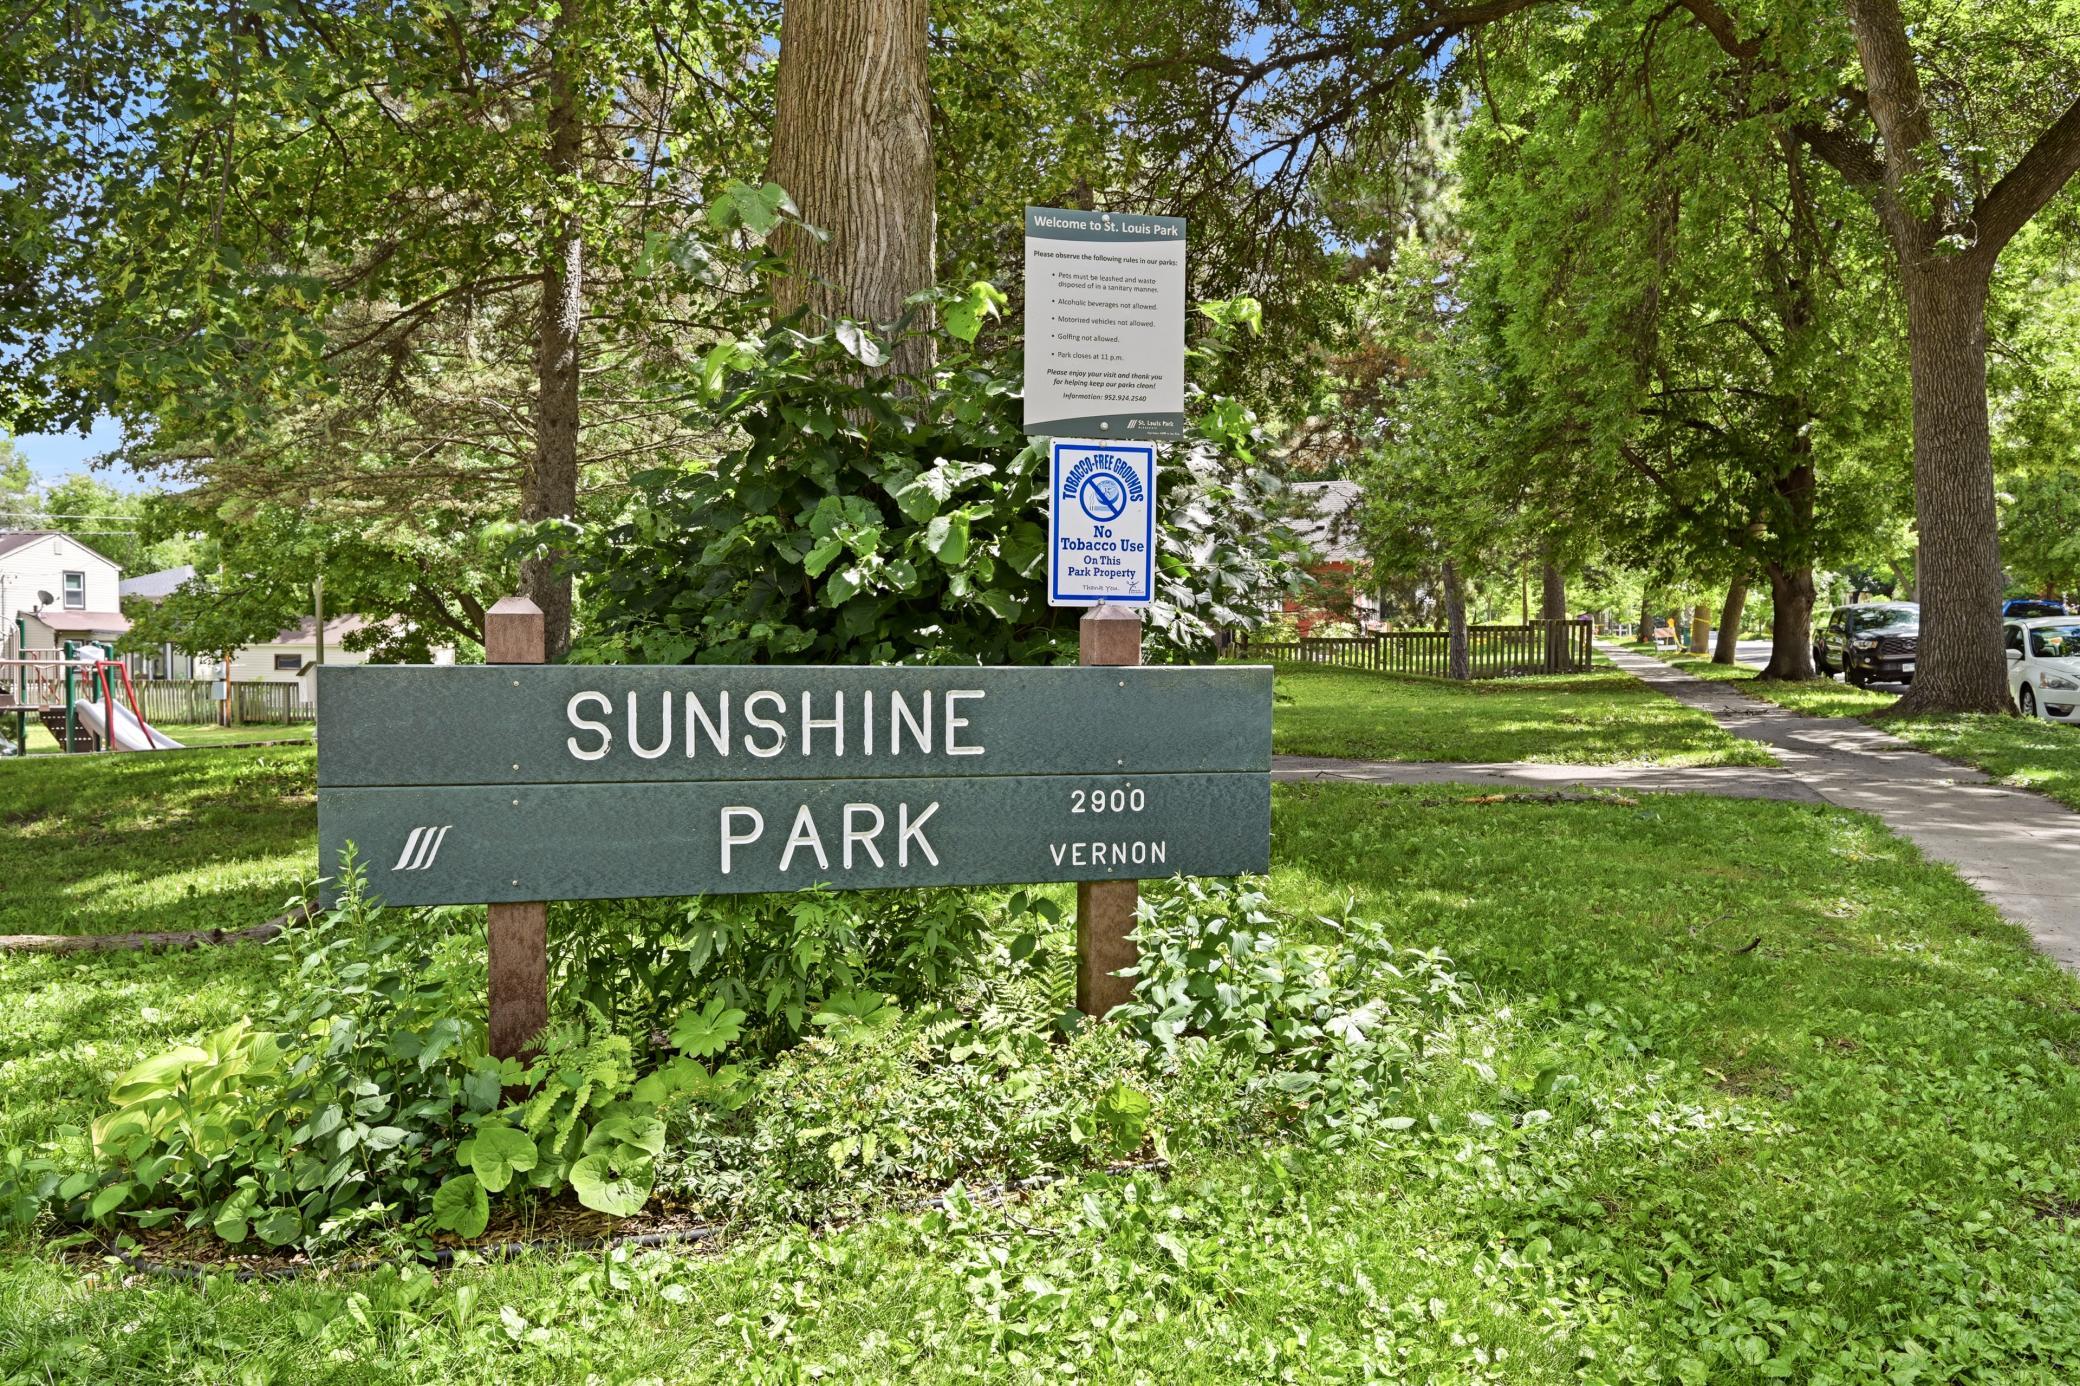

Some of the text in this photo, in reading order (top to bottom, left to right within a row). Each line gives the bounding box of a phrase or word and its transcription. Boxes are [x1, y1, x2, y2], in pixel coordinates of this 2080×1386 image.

[1034, 216, 1178, 236] Welcome to St. Louis Park
[1093, 255, 1122, 264] following
[1088, 300, 1118, 309] beverages
[1058, 333, 1080, 342] Golfing
[1065, 379, 1088, 387] helping
[1063, 454, 1144, 502] TOBACCO-FREE GROUNDS
[1094, 525, 1112, 538] No
[1061, 538, 1144, 552] Tobacco Use
[1084, 556, 1121, 565] On This
[1068, 567, 1136, 579] Park Property
[567, 689, 985, 760] SUNSHINE
[1071, 789, 1144, 813] 2900
[720, 802, 939, 874] PARK
[1050, 841, 1166, 866] VERNON
